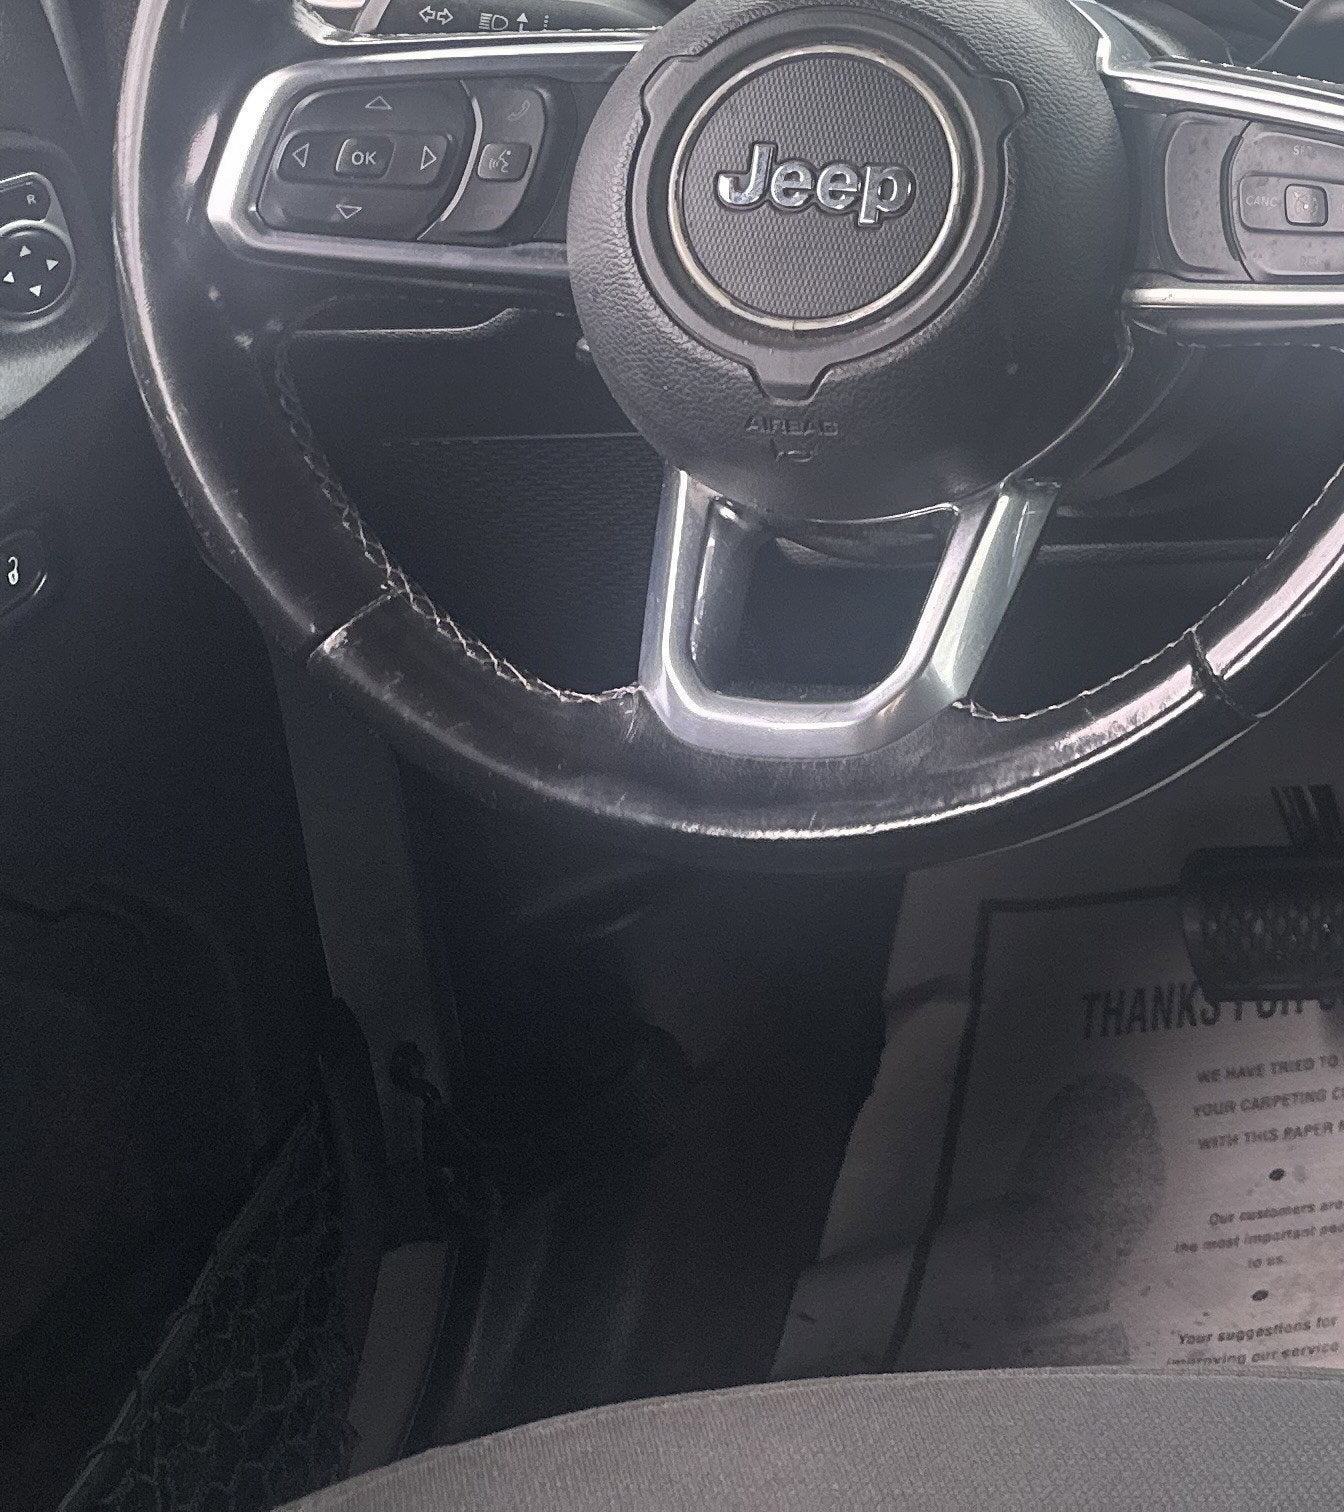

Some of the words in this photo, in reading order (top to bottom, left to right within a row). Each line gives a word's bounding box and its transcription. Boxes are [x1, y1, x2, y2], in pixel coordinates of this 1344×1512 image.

[350, 149, 377, 167] OK
[717, 142, 916, 227] Jeep
[26, 194, 37, 205] R
[1082, 980, 1220, 1040] THANKS
[1225, 1063, 1265, 1080] HAVE
[1270, 1057, 1315, 1074] TRIED
[1319, 1054, 1338, 1068] TO
[1194, 1100, 1236, 1117] YOUR
[1240, 1088, 1327, 1113] CARPETING
[1198, 1134, 1239, 1150] WITH
[1244, 1128, 1279, 1143] THIS
[1283, 1122, 1334, 1140] PAPER
[1209, 1212, 1235, 1226] Our
[1239, 1203, 1316, 1222] customers
[1320, 1200, 1344, 1212] are
[1202, 1236, 1240, 1250] most
[1243, 1226, 1317, 1245] important
[1178, 1333, 1212, 1345] Your
[1217, 1320, 1311, 1343] suggestions
[1316, 1316, 1338, 1329] for
[1281, 1341, 1339, 1358] service
